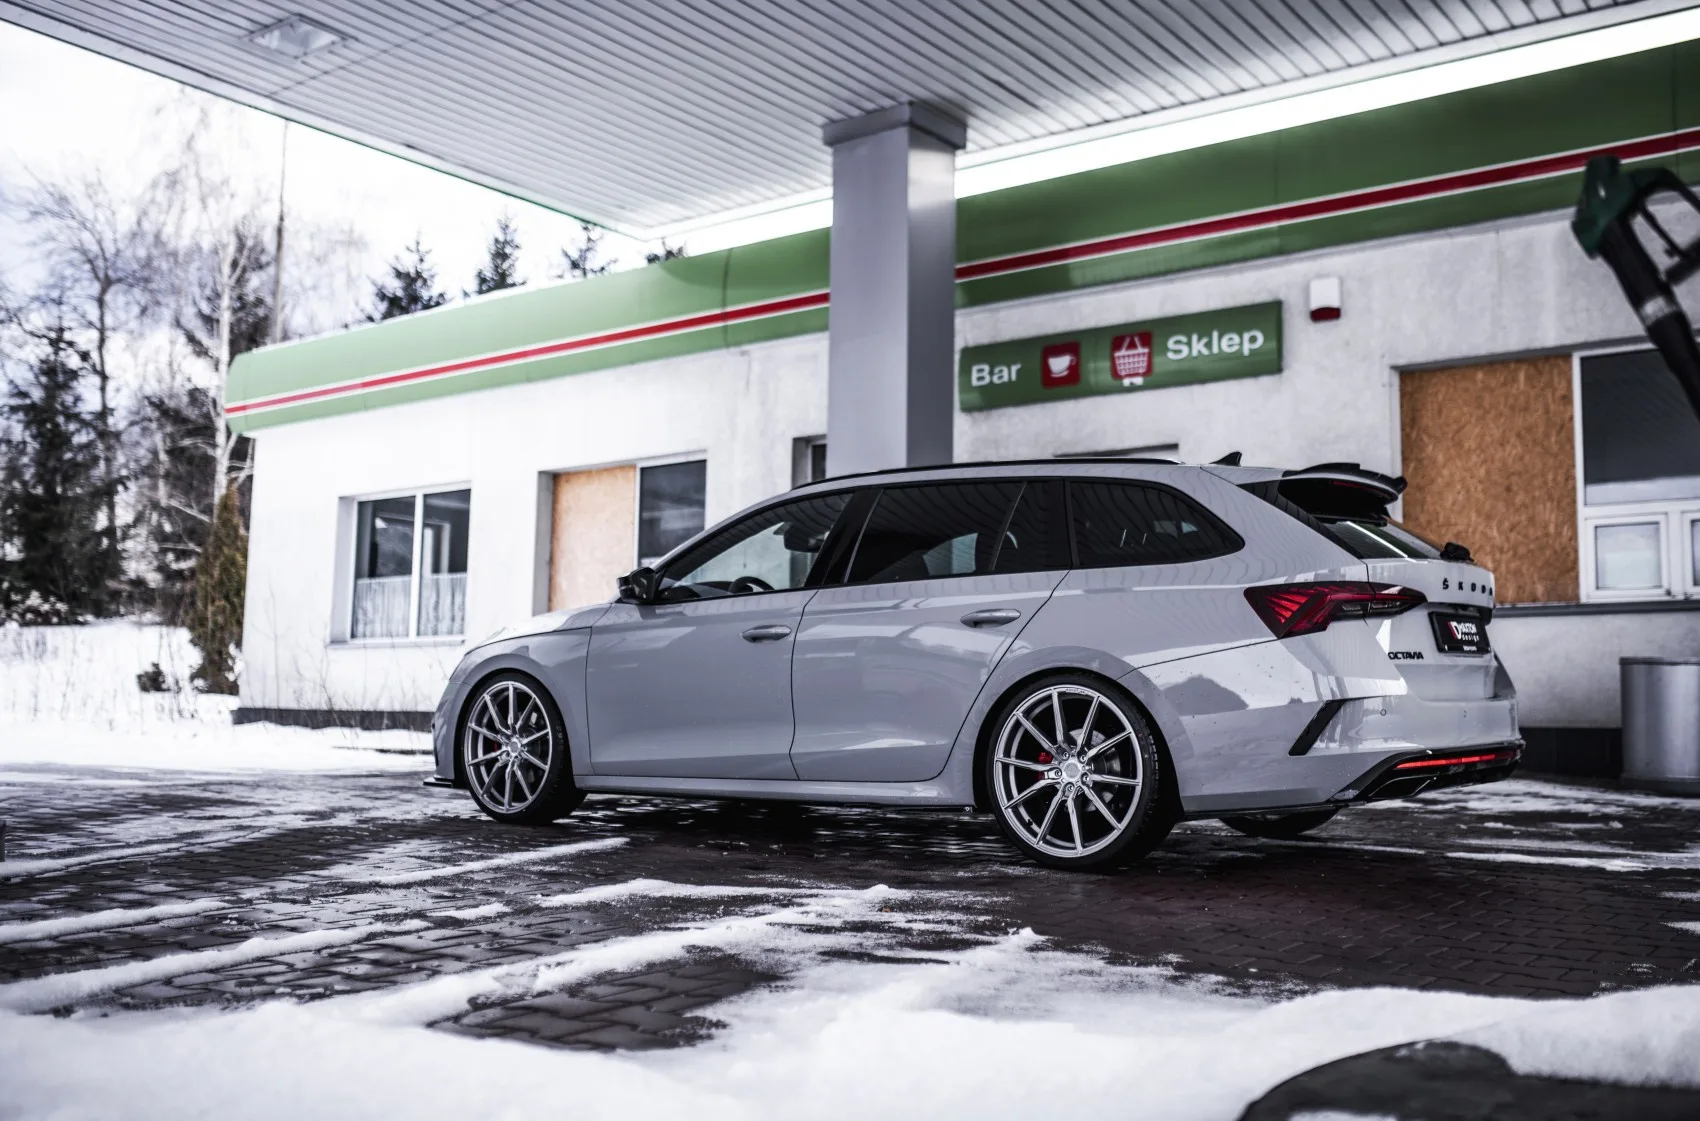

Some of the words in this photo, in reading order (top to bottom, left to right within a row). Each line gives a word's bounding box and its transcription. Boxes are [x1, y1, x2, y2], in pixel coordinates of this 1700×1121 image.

[971, 363, 1022, 387] Bar
[1166, 329, 1266, 361] Sklep
[1387, 651, 1425, 660] OCTAVIA
